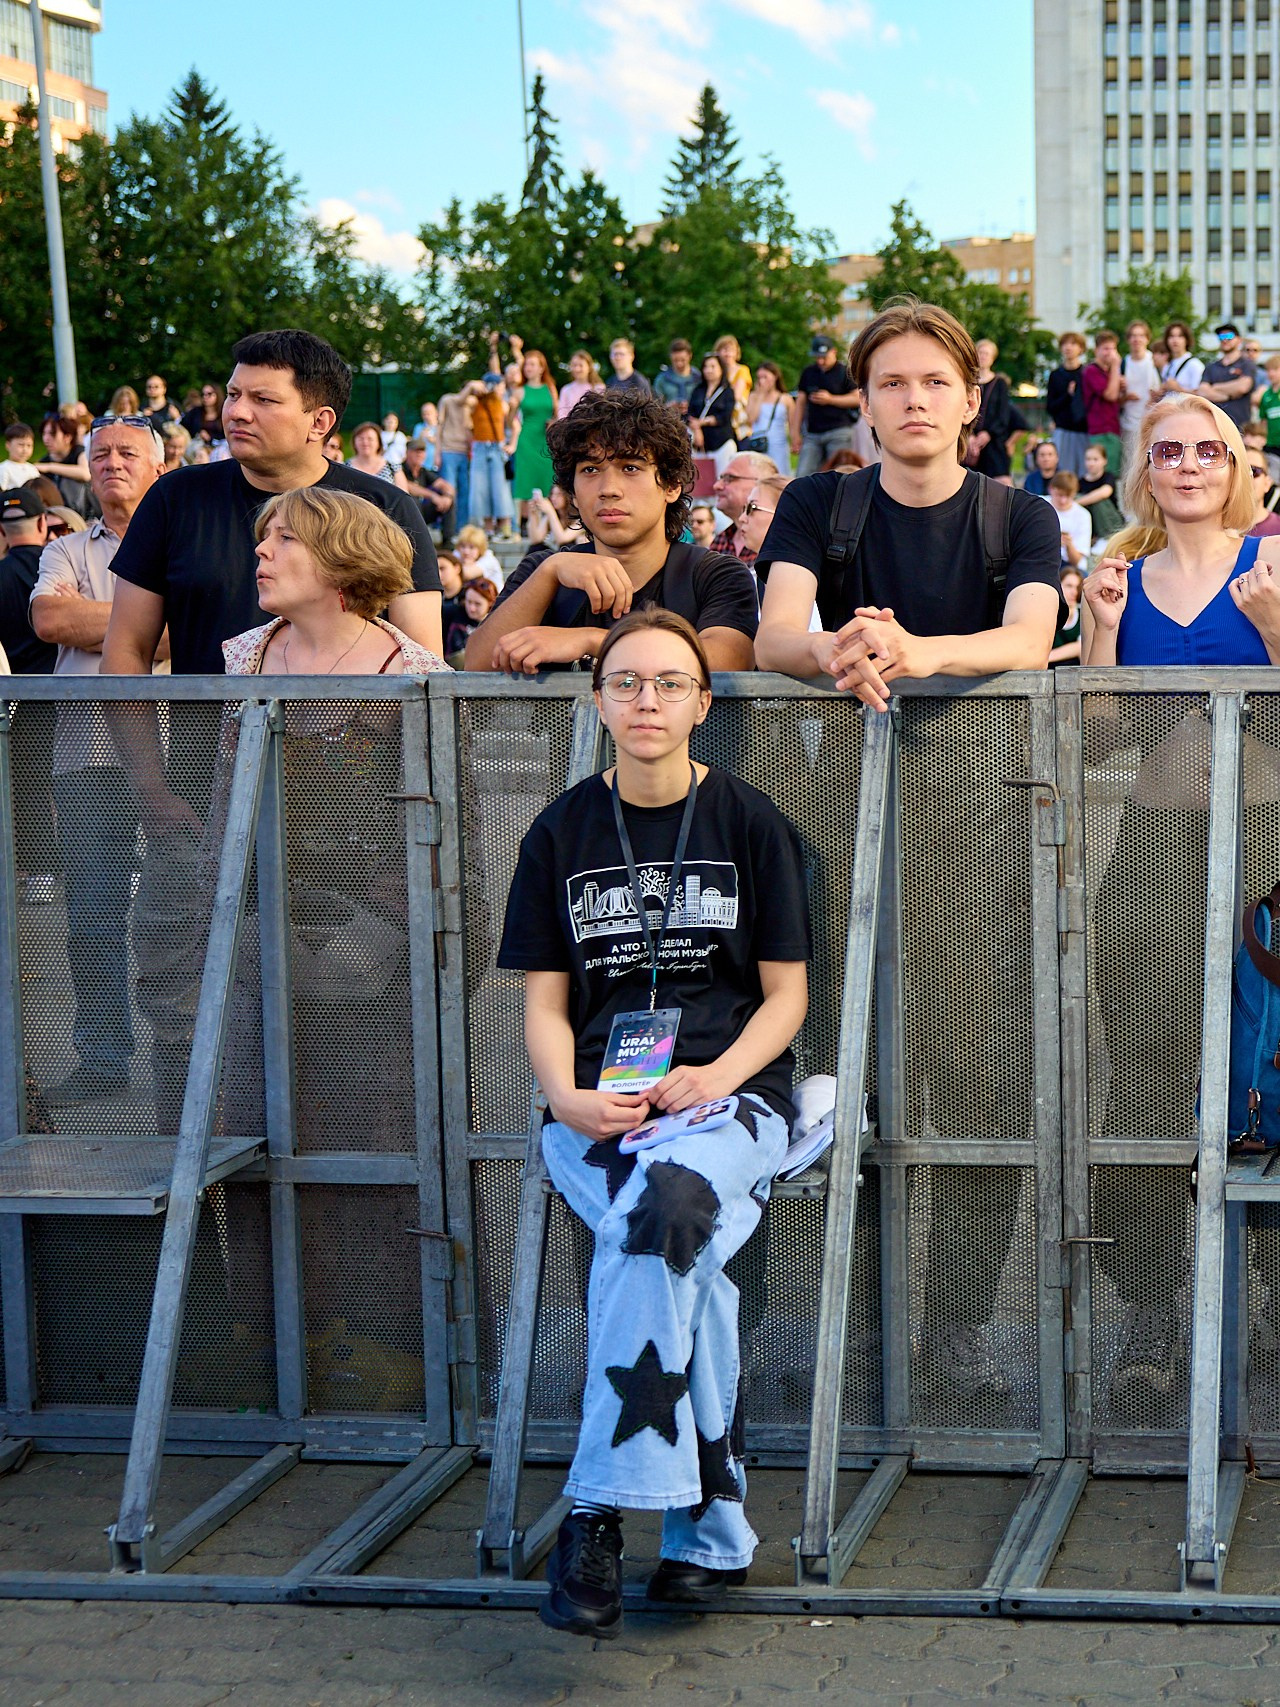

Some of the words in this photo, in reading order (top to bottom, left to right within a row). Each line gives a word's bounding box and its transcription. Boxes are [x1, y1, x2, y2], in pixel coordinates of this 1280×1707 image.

[611, 945, 620, 953] А
[620, 942, 641, 952] ЧТО
[585, 957, 602, 970] ДЛЯ
[602, 950, 655, 966] УРАЛЬСКО
[620, 1036, 657, 1048] URAL
